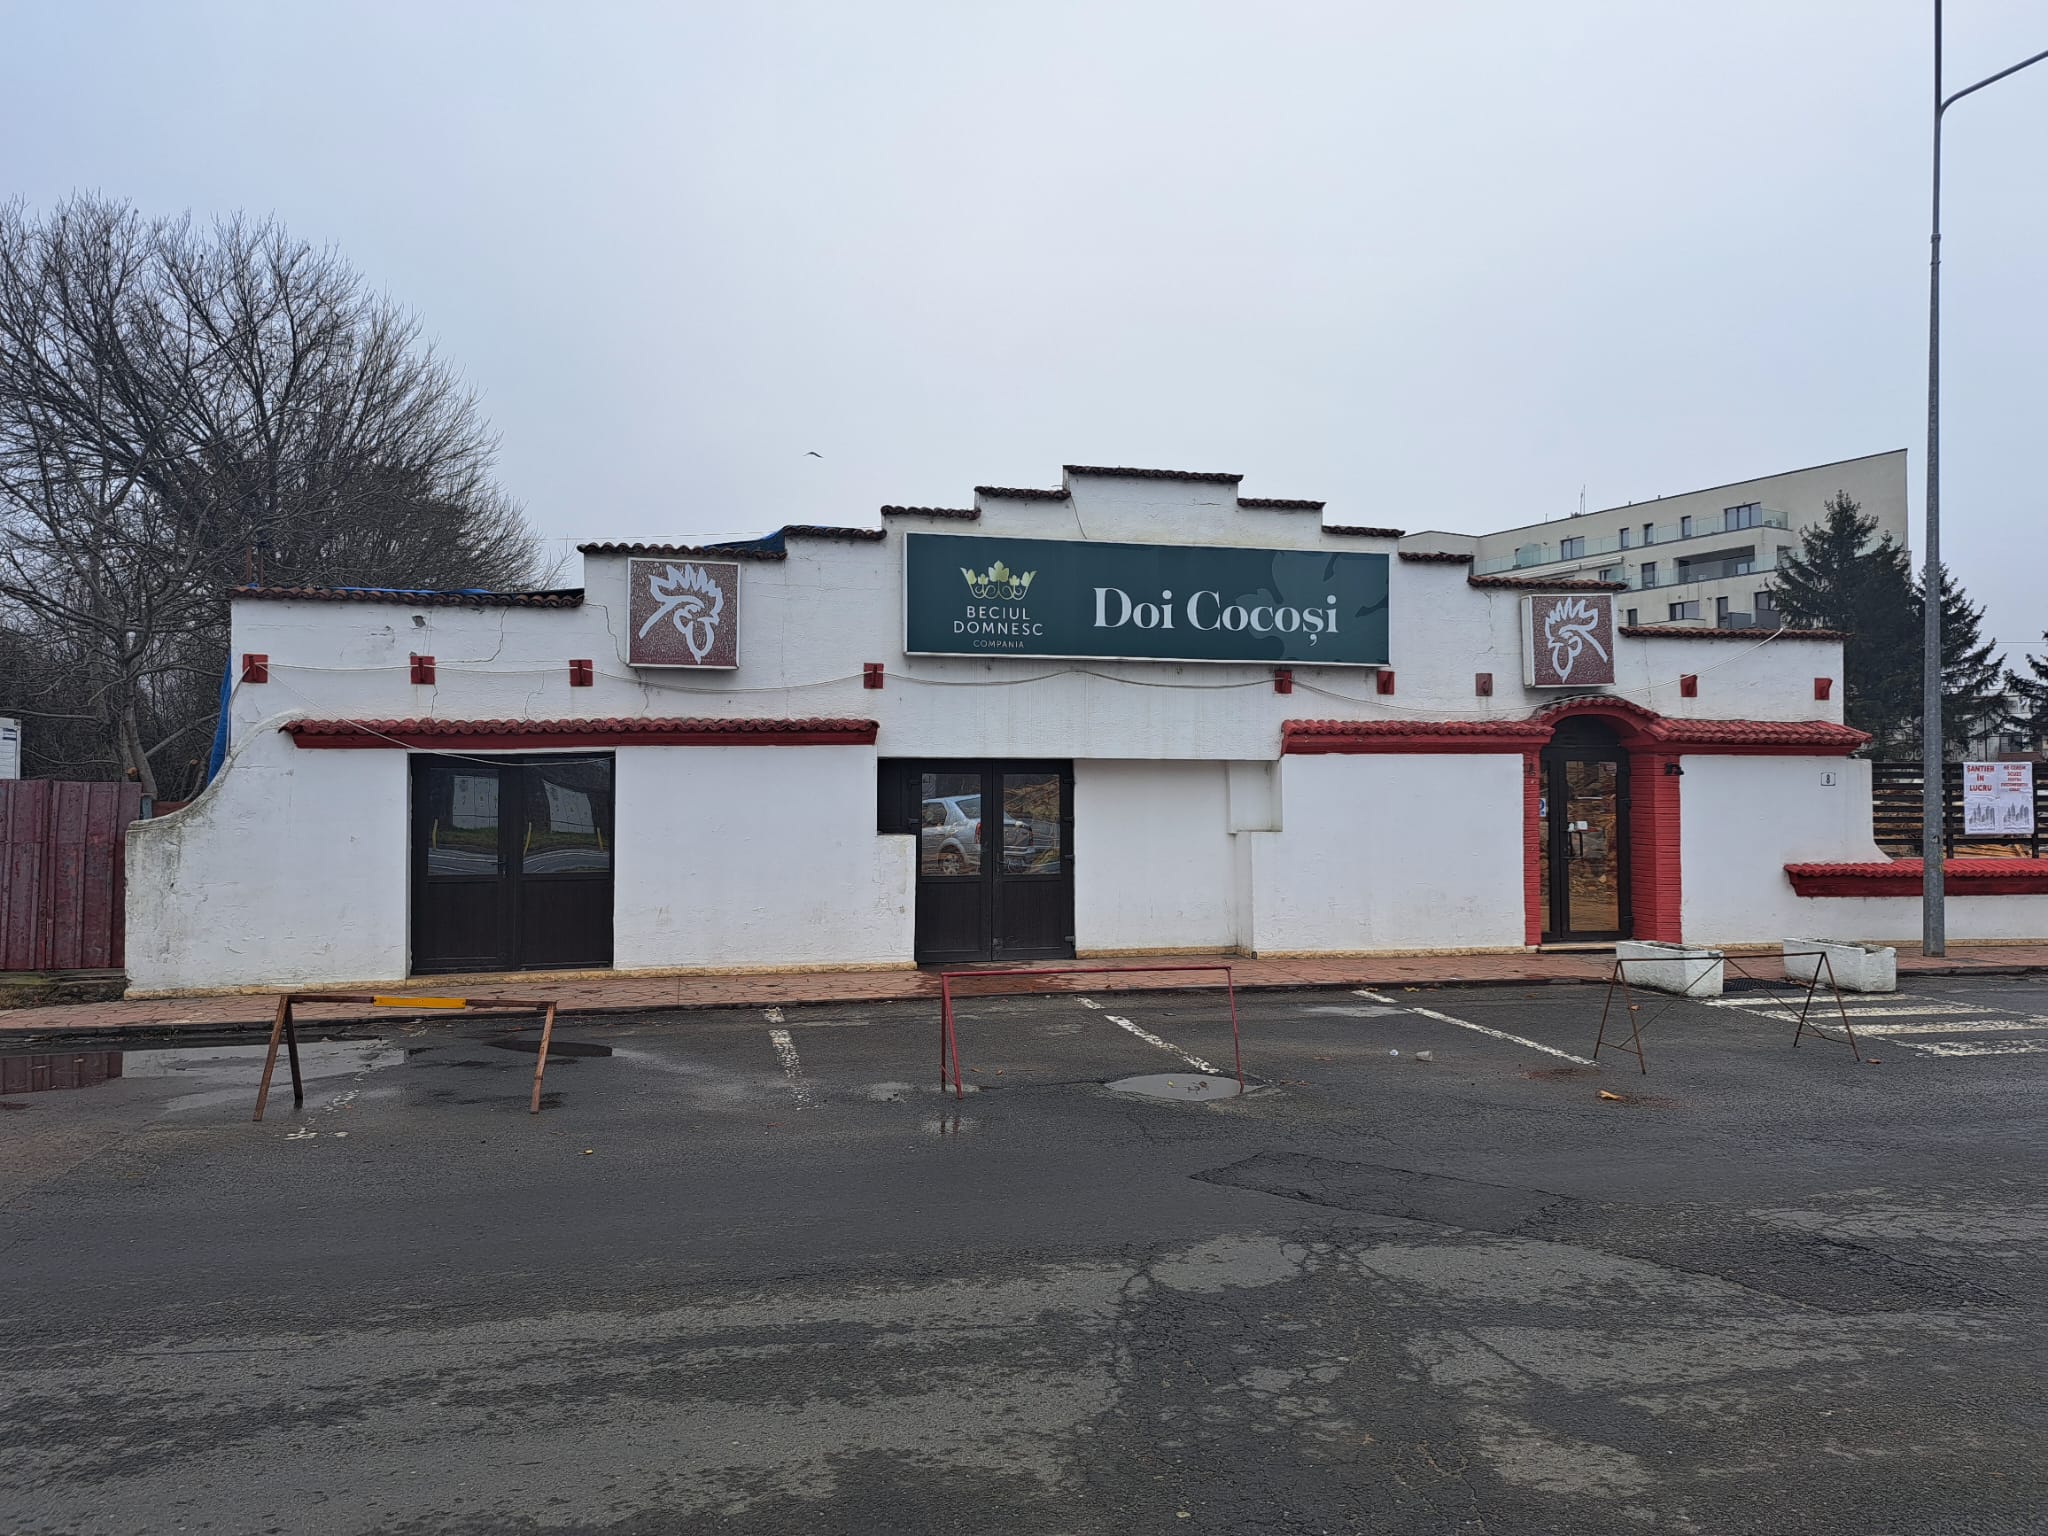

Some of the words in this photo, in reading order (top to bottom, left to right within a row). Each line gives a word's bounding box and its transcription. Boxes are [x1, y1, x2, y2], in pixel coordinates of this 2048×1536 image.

[966, 605, 1031, 620] BECIUL
[1093, 587, 1176, 629] Doi
[1186, 590, 1339, 646] Cocoși
[953, 620, 1043, 636] DOMNESC
[973, 639, 1024, 649] COMPANIA
